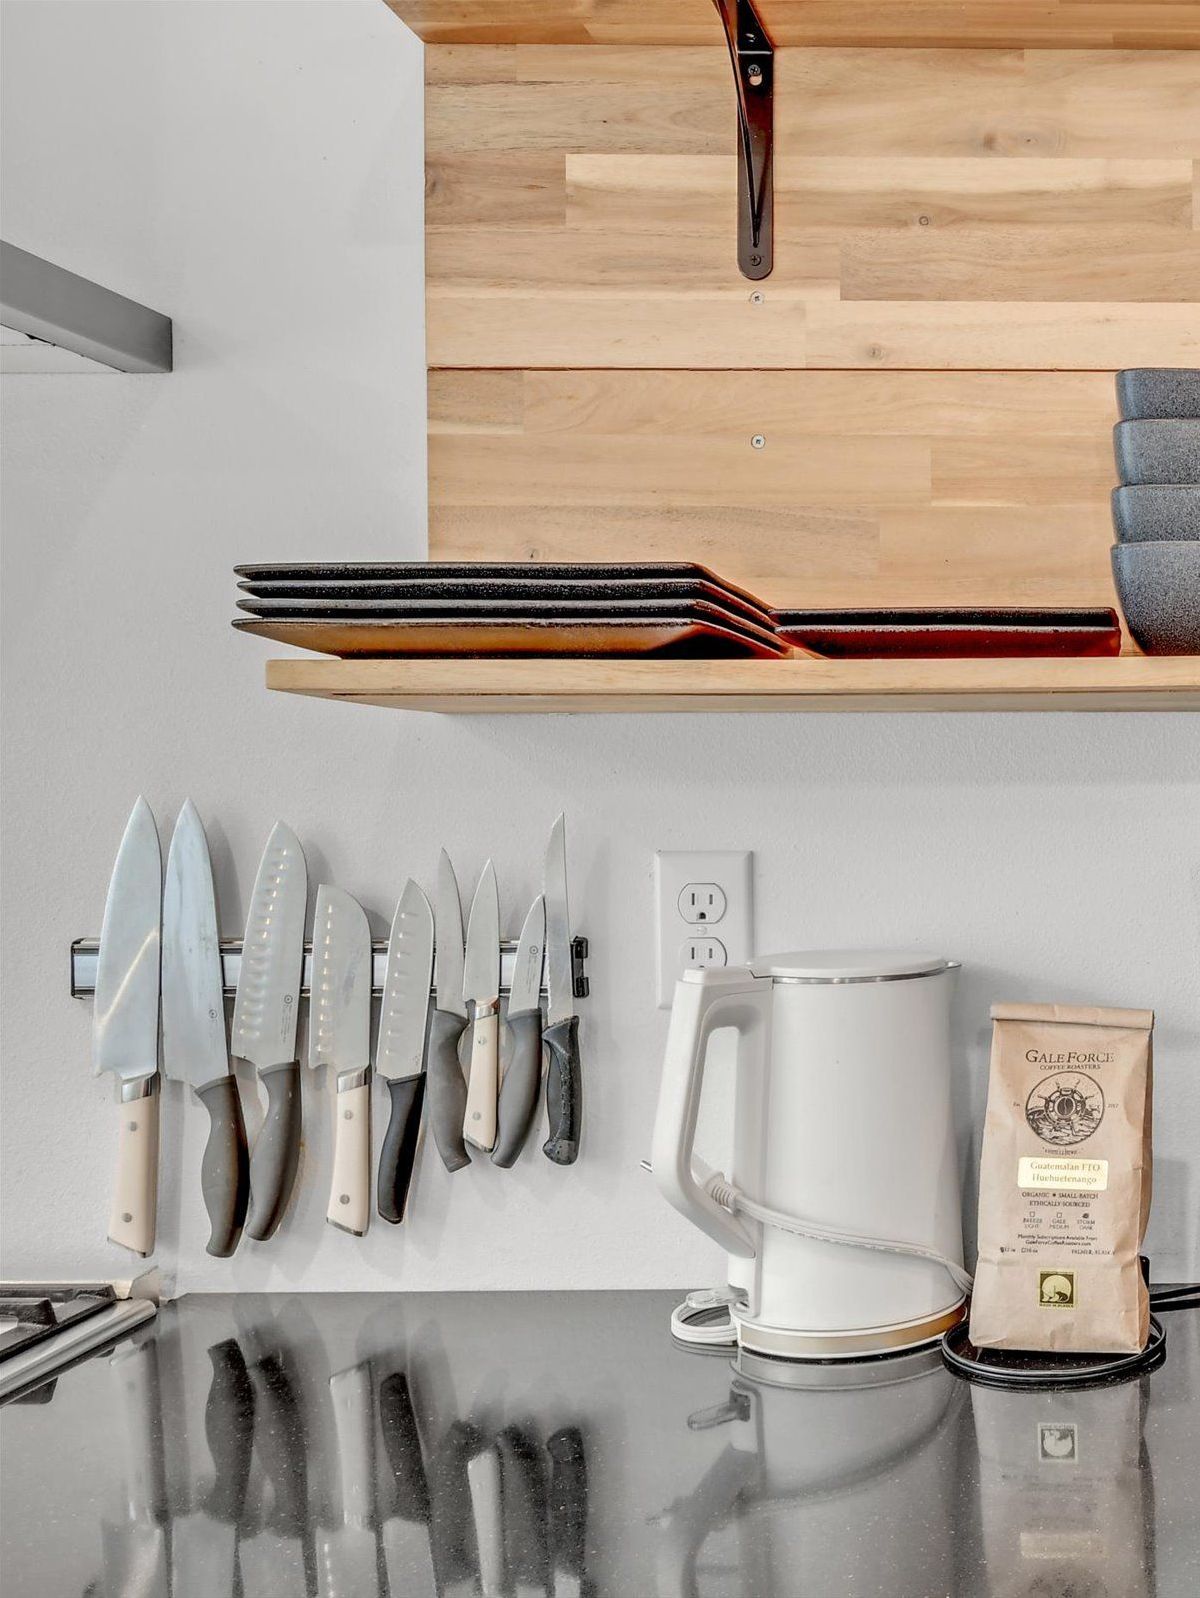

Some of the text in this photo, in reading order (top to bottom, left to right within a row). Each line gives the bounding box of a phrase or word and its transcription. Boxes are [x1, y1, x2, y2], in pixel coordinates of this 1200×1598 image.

[1030, 1161, 1101, 1172] Guatemalan FTO
[1032, 1173, 1097, 1185] Huehuetenango
[1078, 1192, 1099, 1200] BATCH
